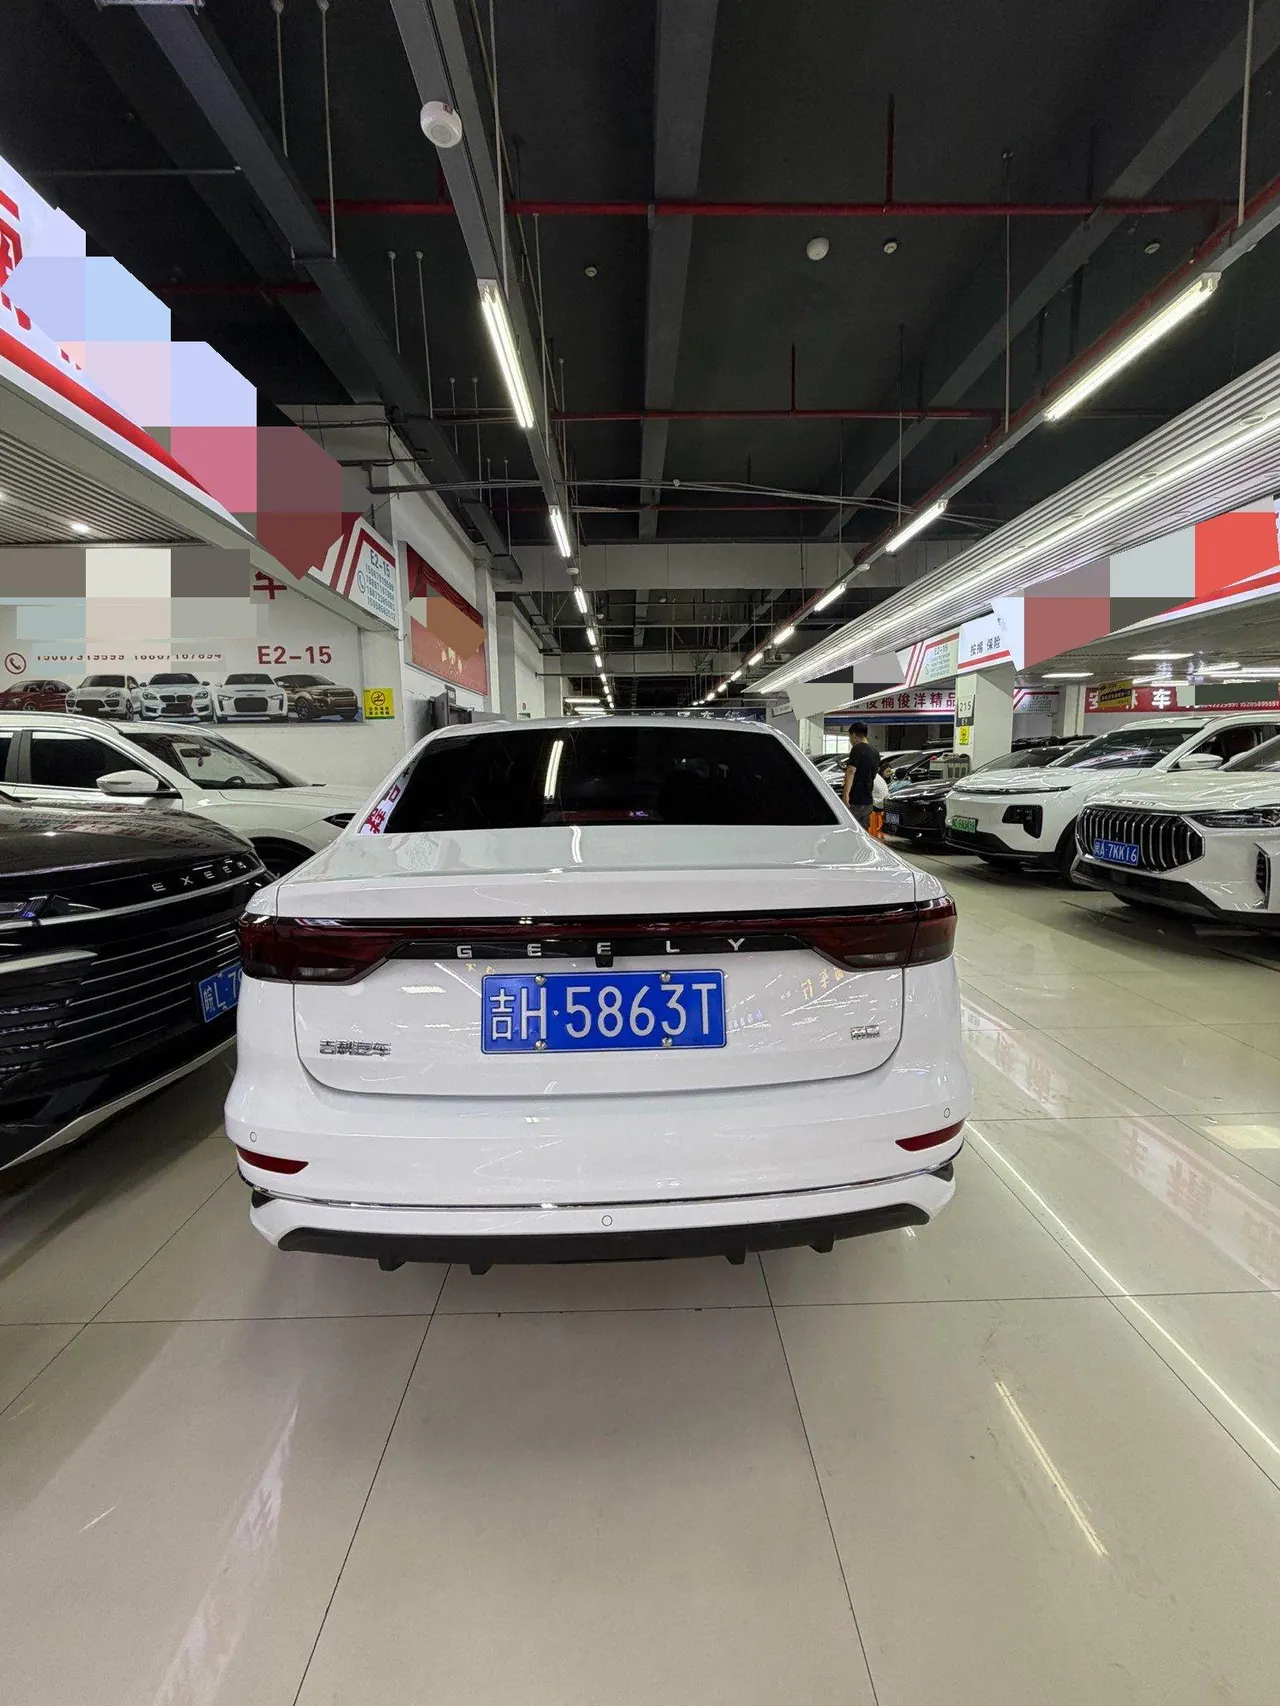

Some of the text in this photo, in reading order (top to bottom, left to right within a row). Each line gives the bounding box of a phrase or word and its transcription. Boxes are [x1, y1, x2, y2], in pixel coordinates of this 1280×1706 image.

[370, 549, 390, 577] E2-15
[257, 646, 332, 664] E2-15
[960, 701, 971, 711] 215
[456, 938, 745, 959] GEELY
